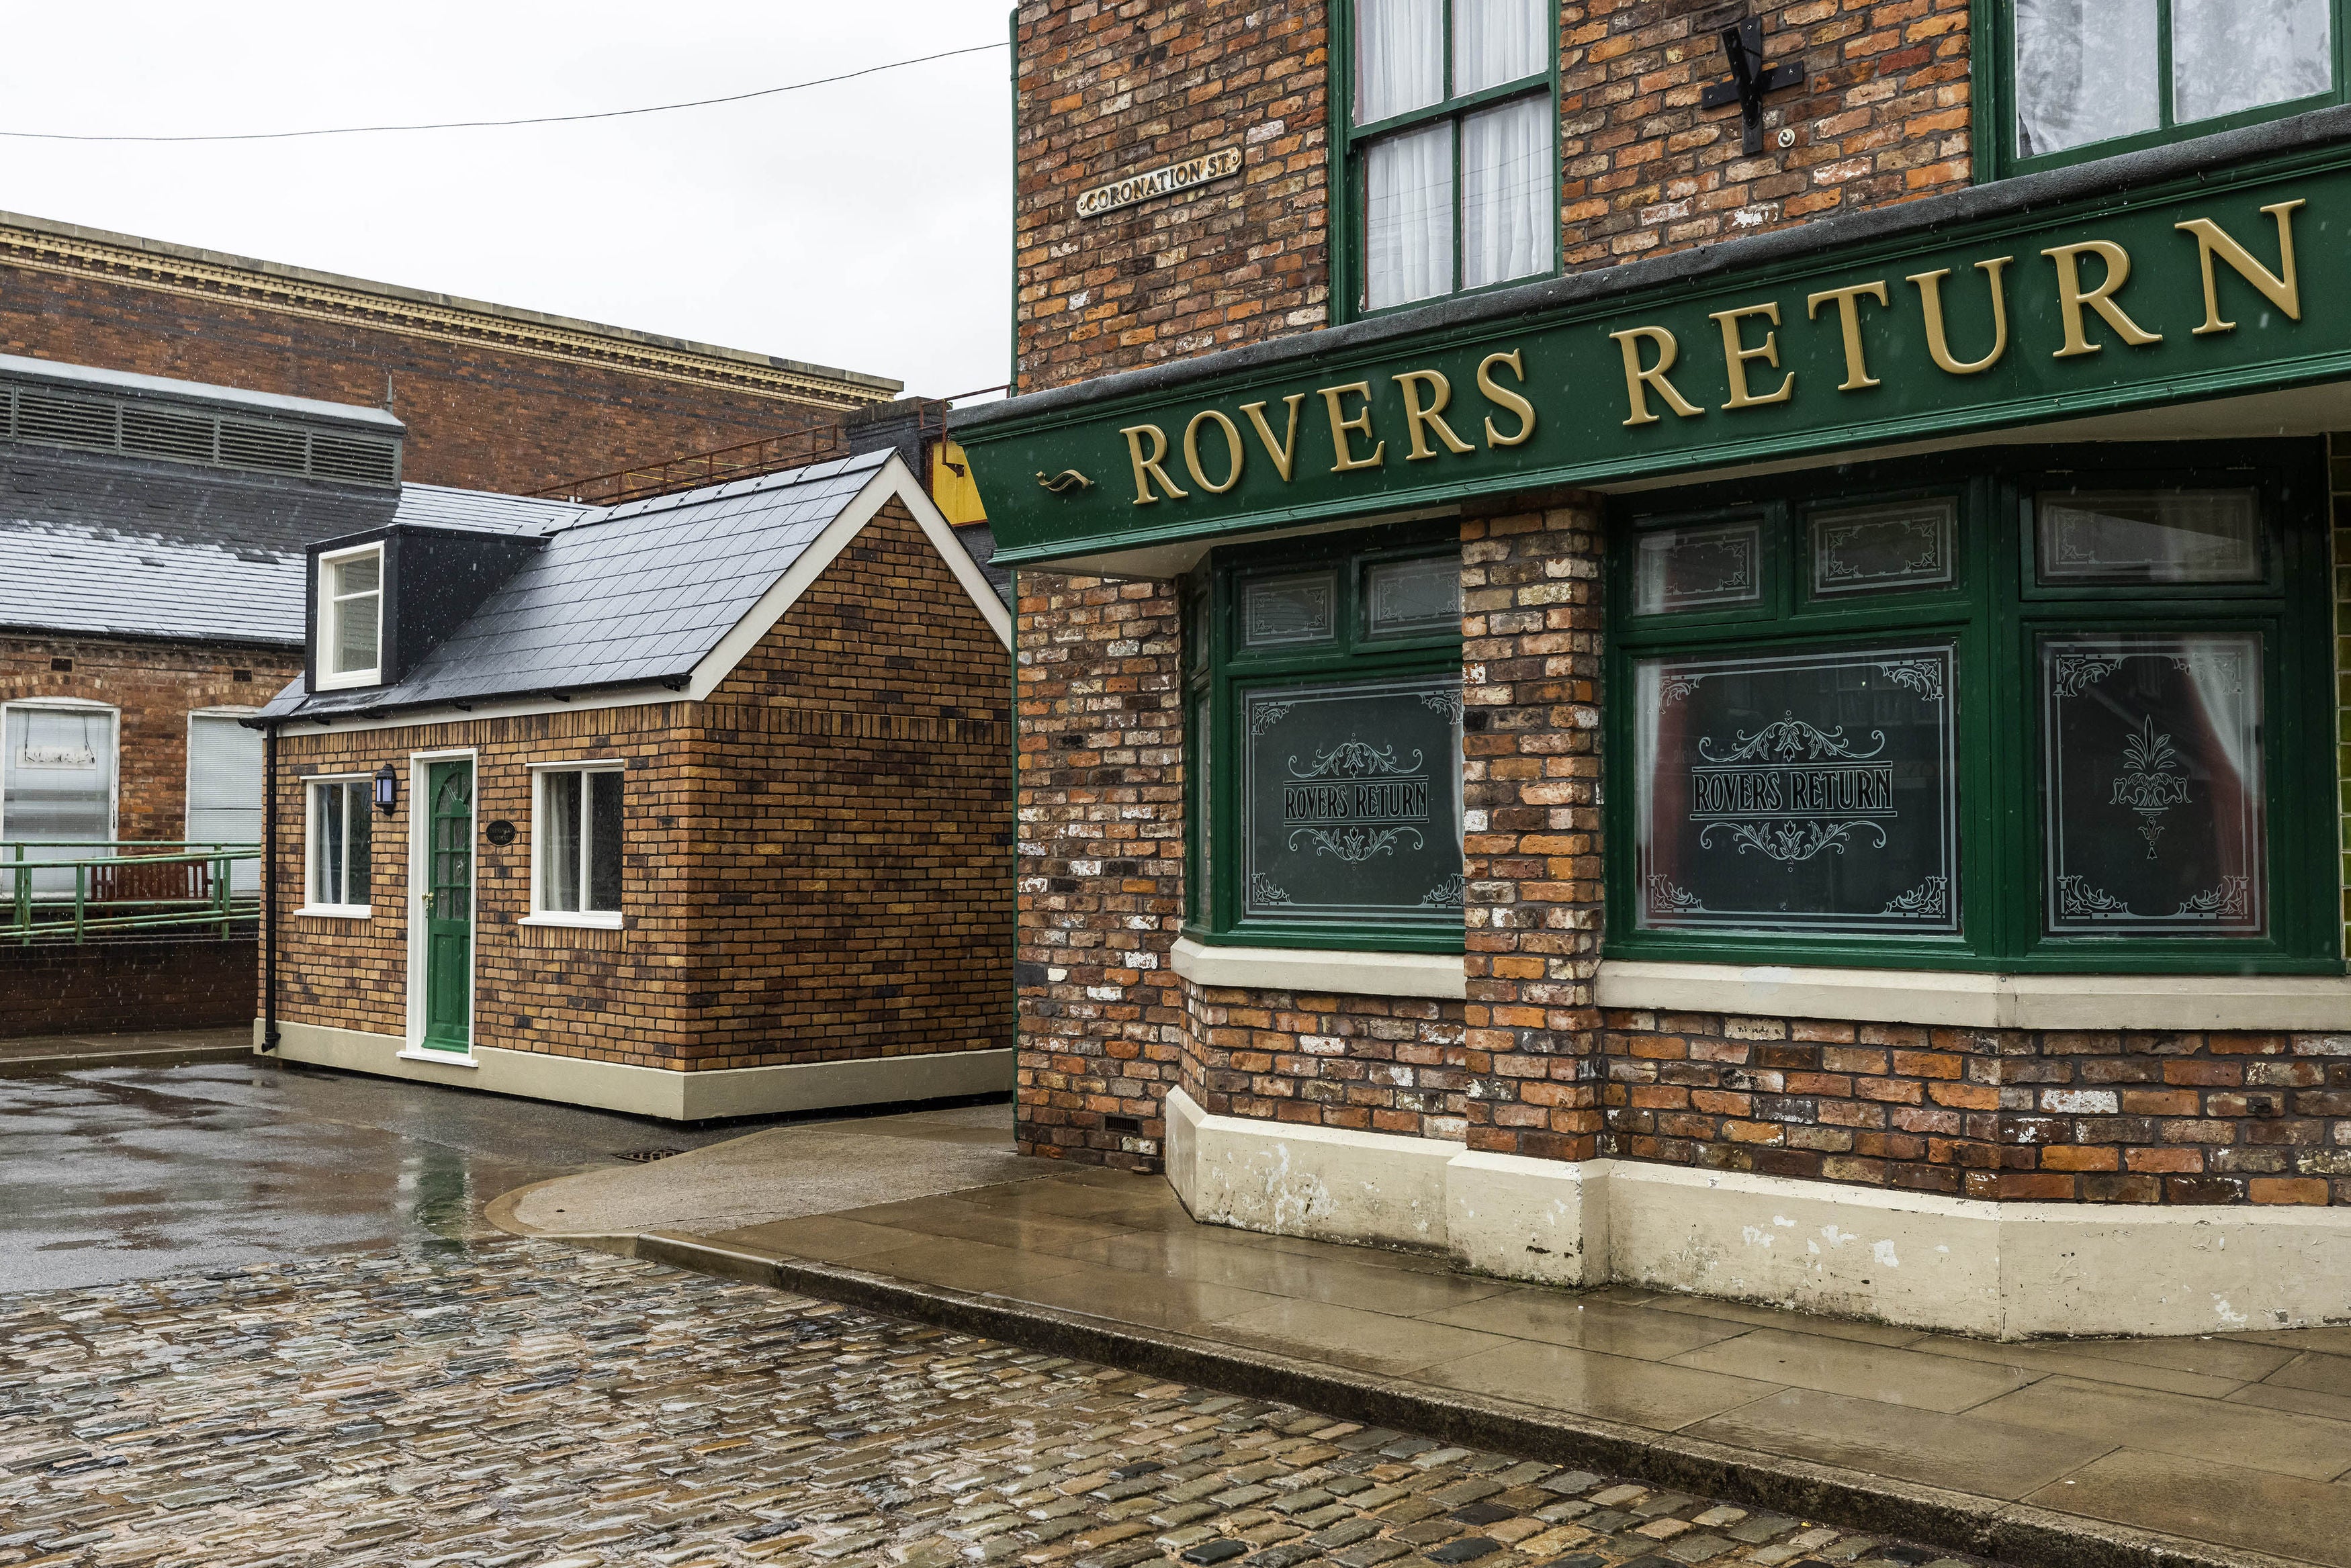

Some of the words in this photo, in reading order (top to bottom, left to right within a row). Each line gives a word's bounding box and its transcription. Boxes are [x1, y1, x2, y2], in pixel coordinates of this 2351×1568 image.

[1086, 160, 1201, 212] CORONATION
[1207, 152, 1231, 177] ST.
[1119, 348, 1536, 506] ROVERS
[1609, 198, 2307, 426] RETURN
[1284, 785, 1349, 819] ROVERS
[1354, 782, 1427, 817] RETURN
[1693, 772, 1782, 811] ROVERS
[1791, 769, 1893, 811] RETURN
